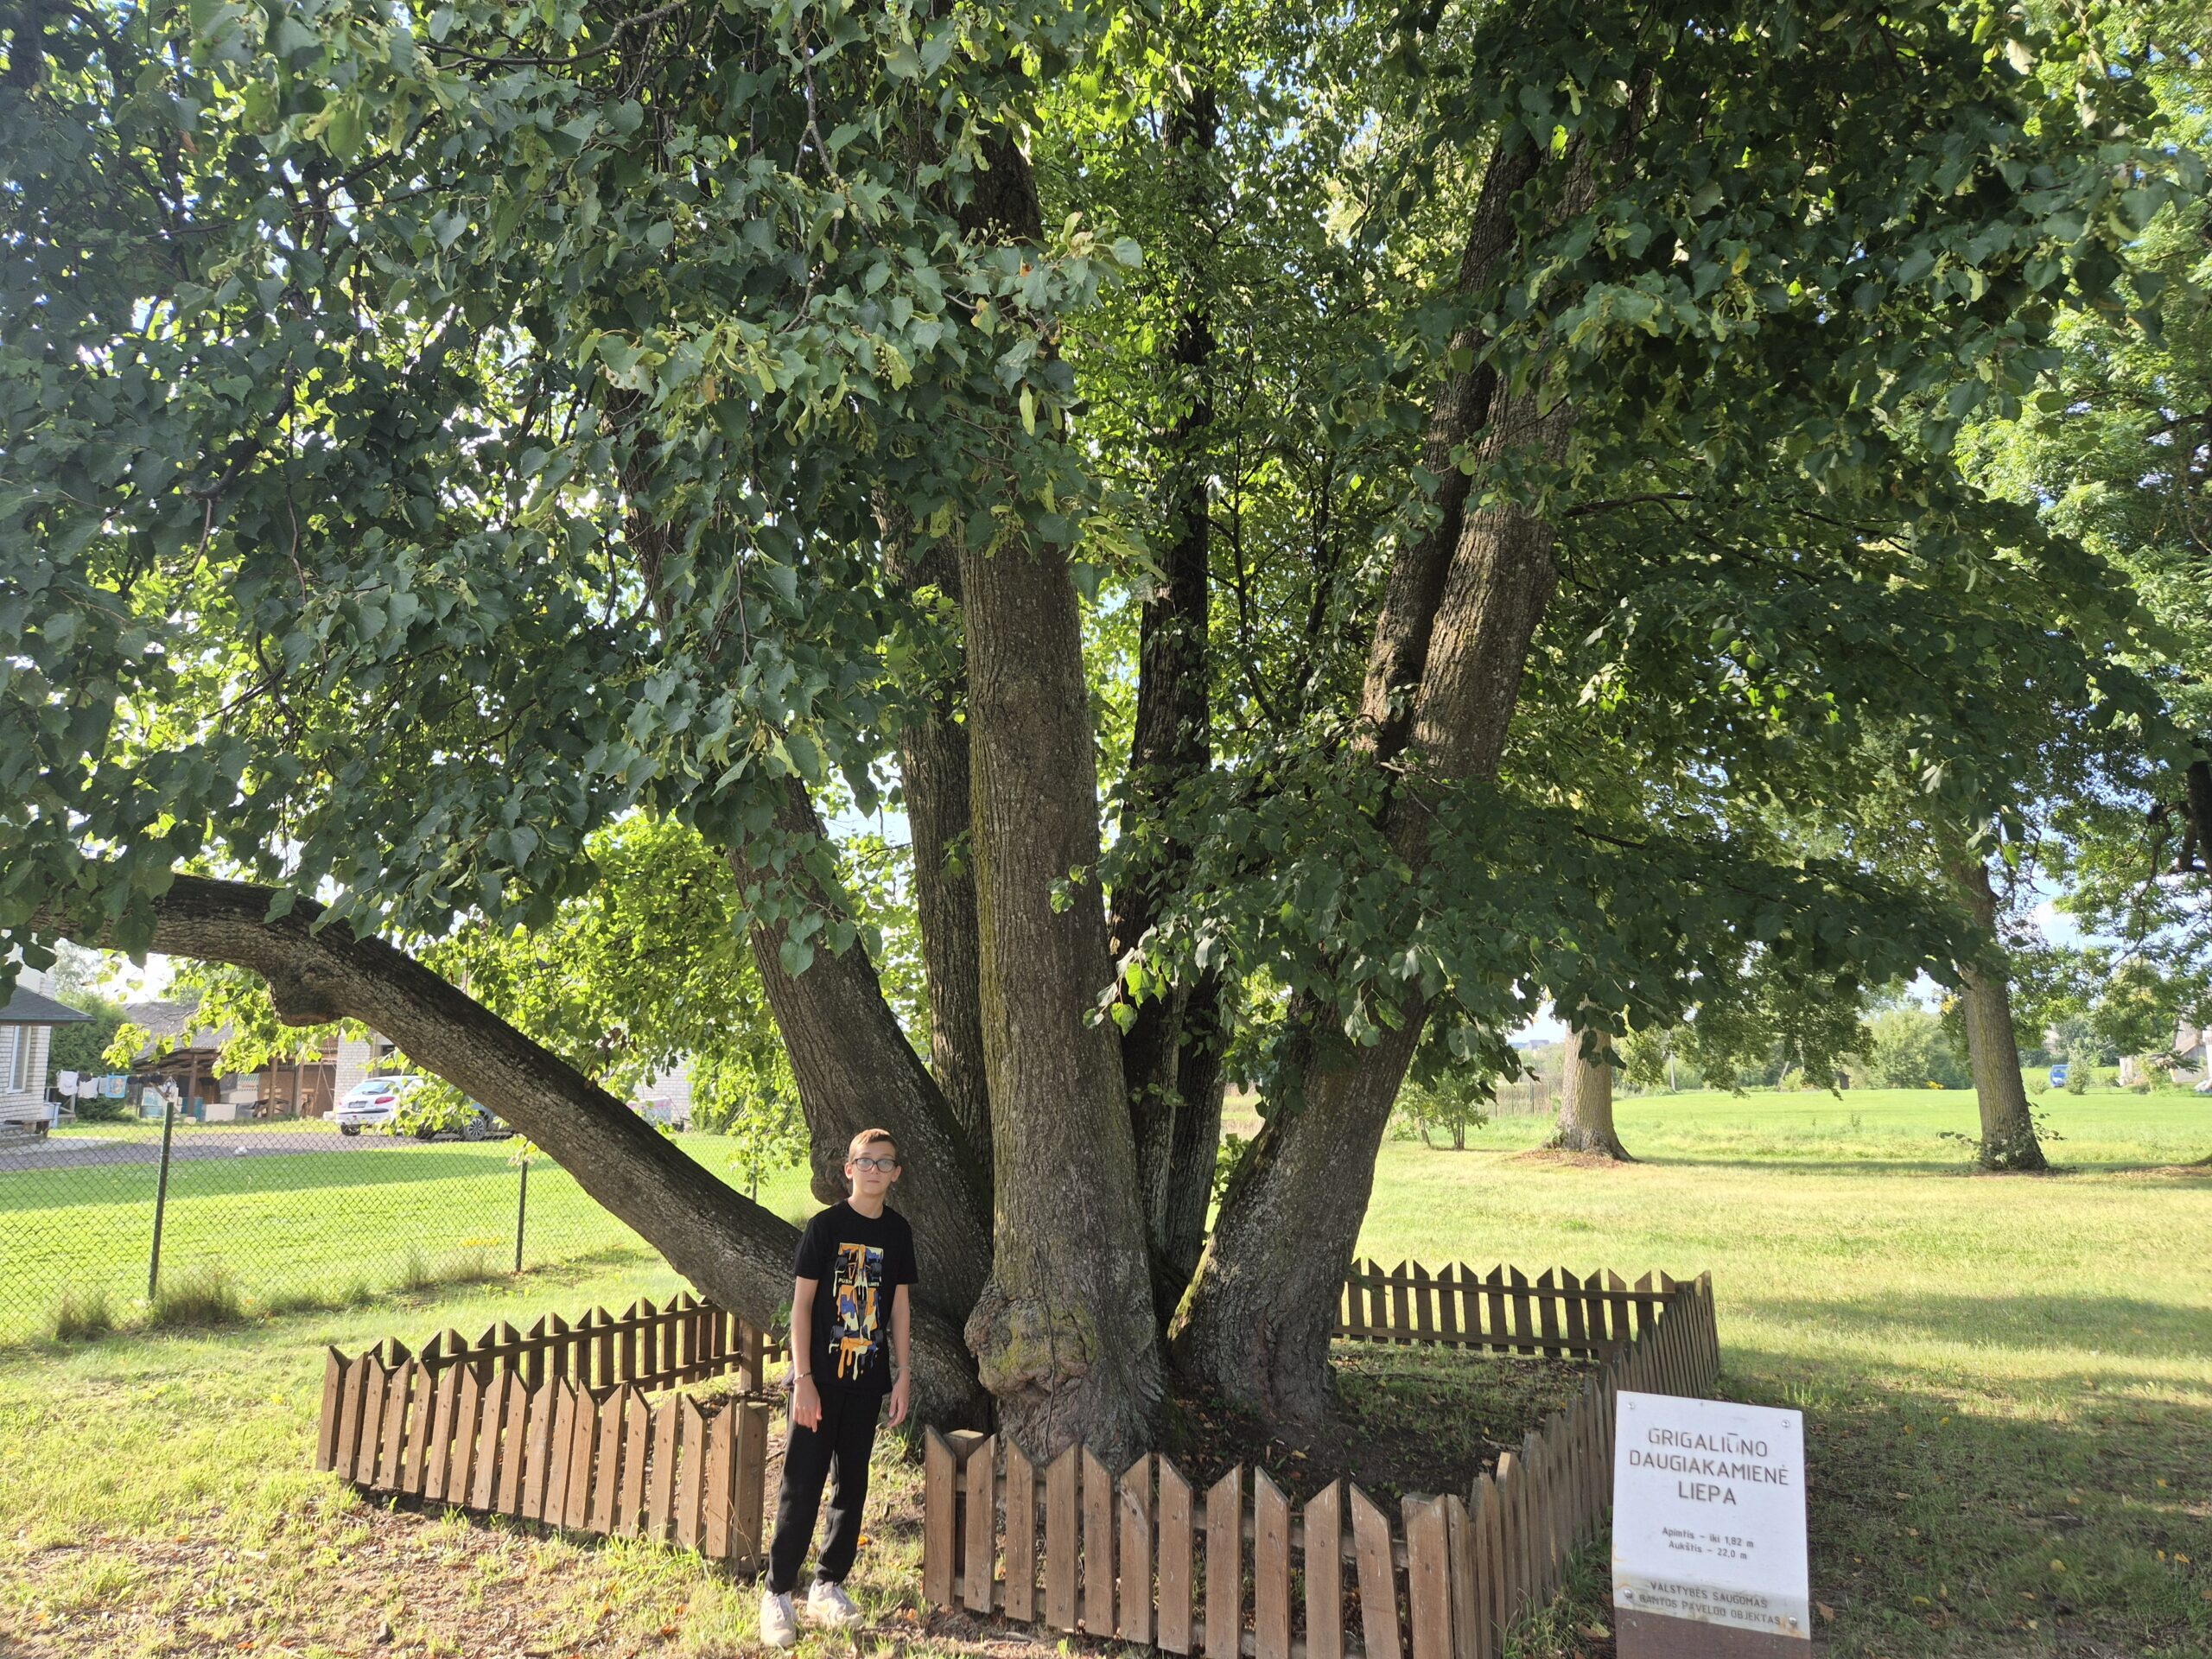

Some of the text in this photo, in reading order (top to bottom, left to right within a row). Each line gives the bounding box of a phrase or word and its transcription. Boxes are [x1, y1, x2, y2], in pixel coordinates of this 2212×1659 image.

[1648, 1427, 1768, 1458] GRIGALIŪNO
[1629, 1449, 1789, 1485] DAUGIAKAMIENĖ
[1677, 1480, 1737, 1505] LIEPA
[1662, 1527, 1695, 1540] Apimtis
[1709, 1533, 1720, 1543] iki
[1725, 1535, 1743, 1547] 1,82
[1746, 1540, 1754, 1548] m
[1669, 1541, 1702, 1553] Aukštis
[1717, 1548, 1736, 1559] 22,0
[1649, 1581, 1768, 1609] VALSTYBĖS SAUGOMAS
[1731, 1610, 1782, 1626] OBJEKTAS
